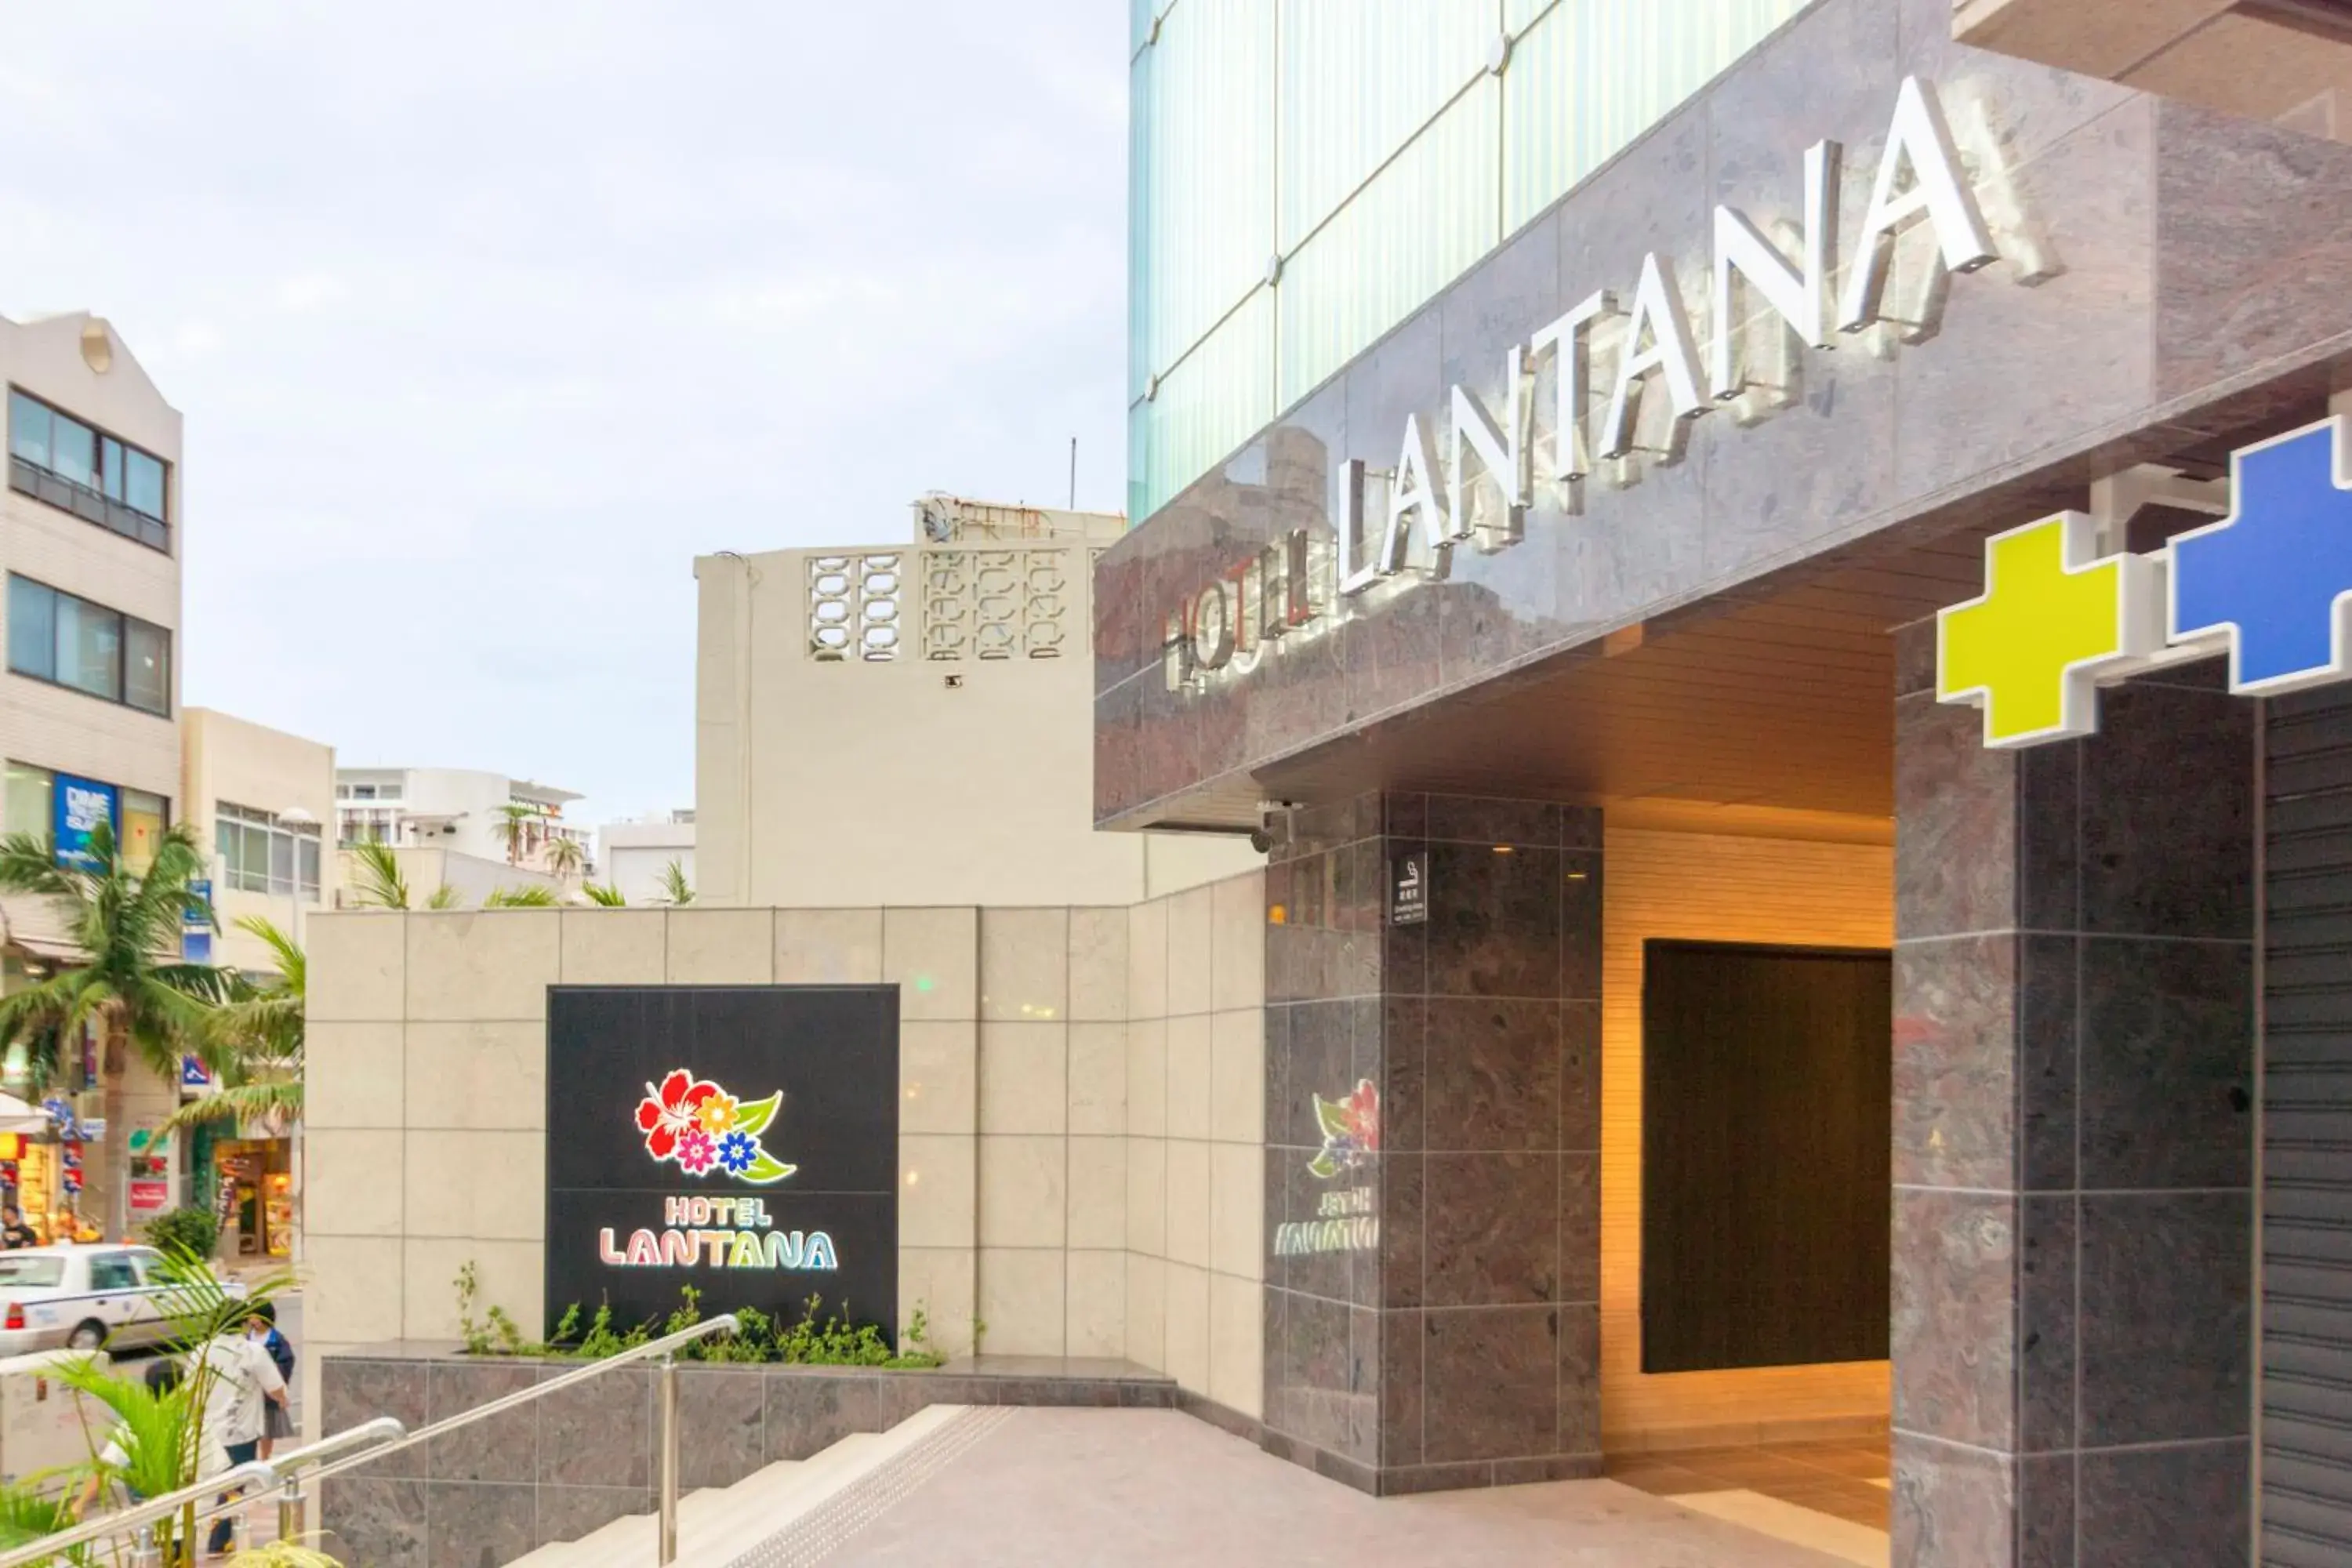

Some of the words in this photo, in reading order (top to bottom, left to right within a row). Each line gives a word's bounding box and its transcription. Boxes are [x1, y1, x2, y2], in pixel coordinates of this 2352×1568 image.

[1162, 528, 1323, 684] HOTEL
[1338, 74, 1998, 594] LANTANA
[665, 1196, 771, 1226] HOTEL
[600, 1227, 837, 1269] LANTANA
